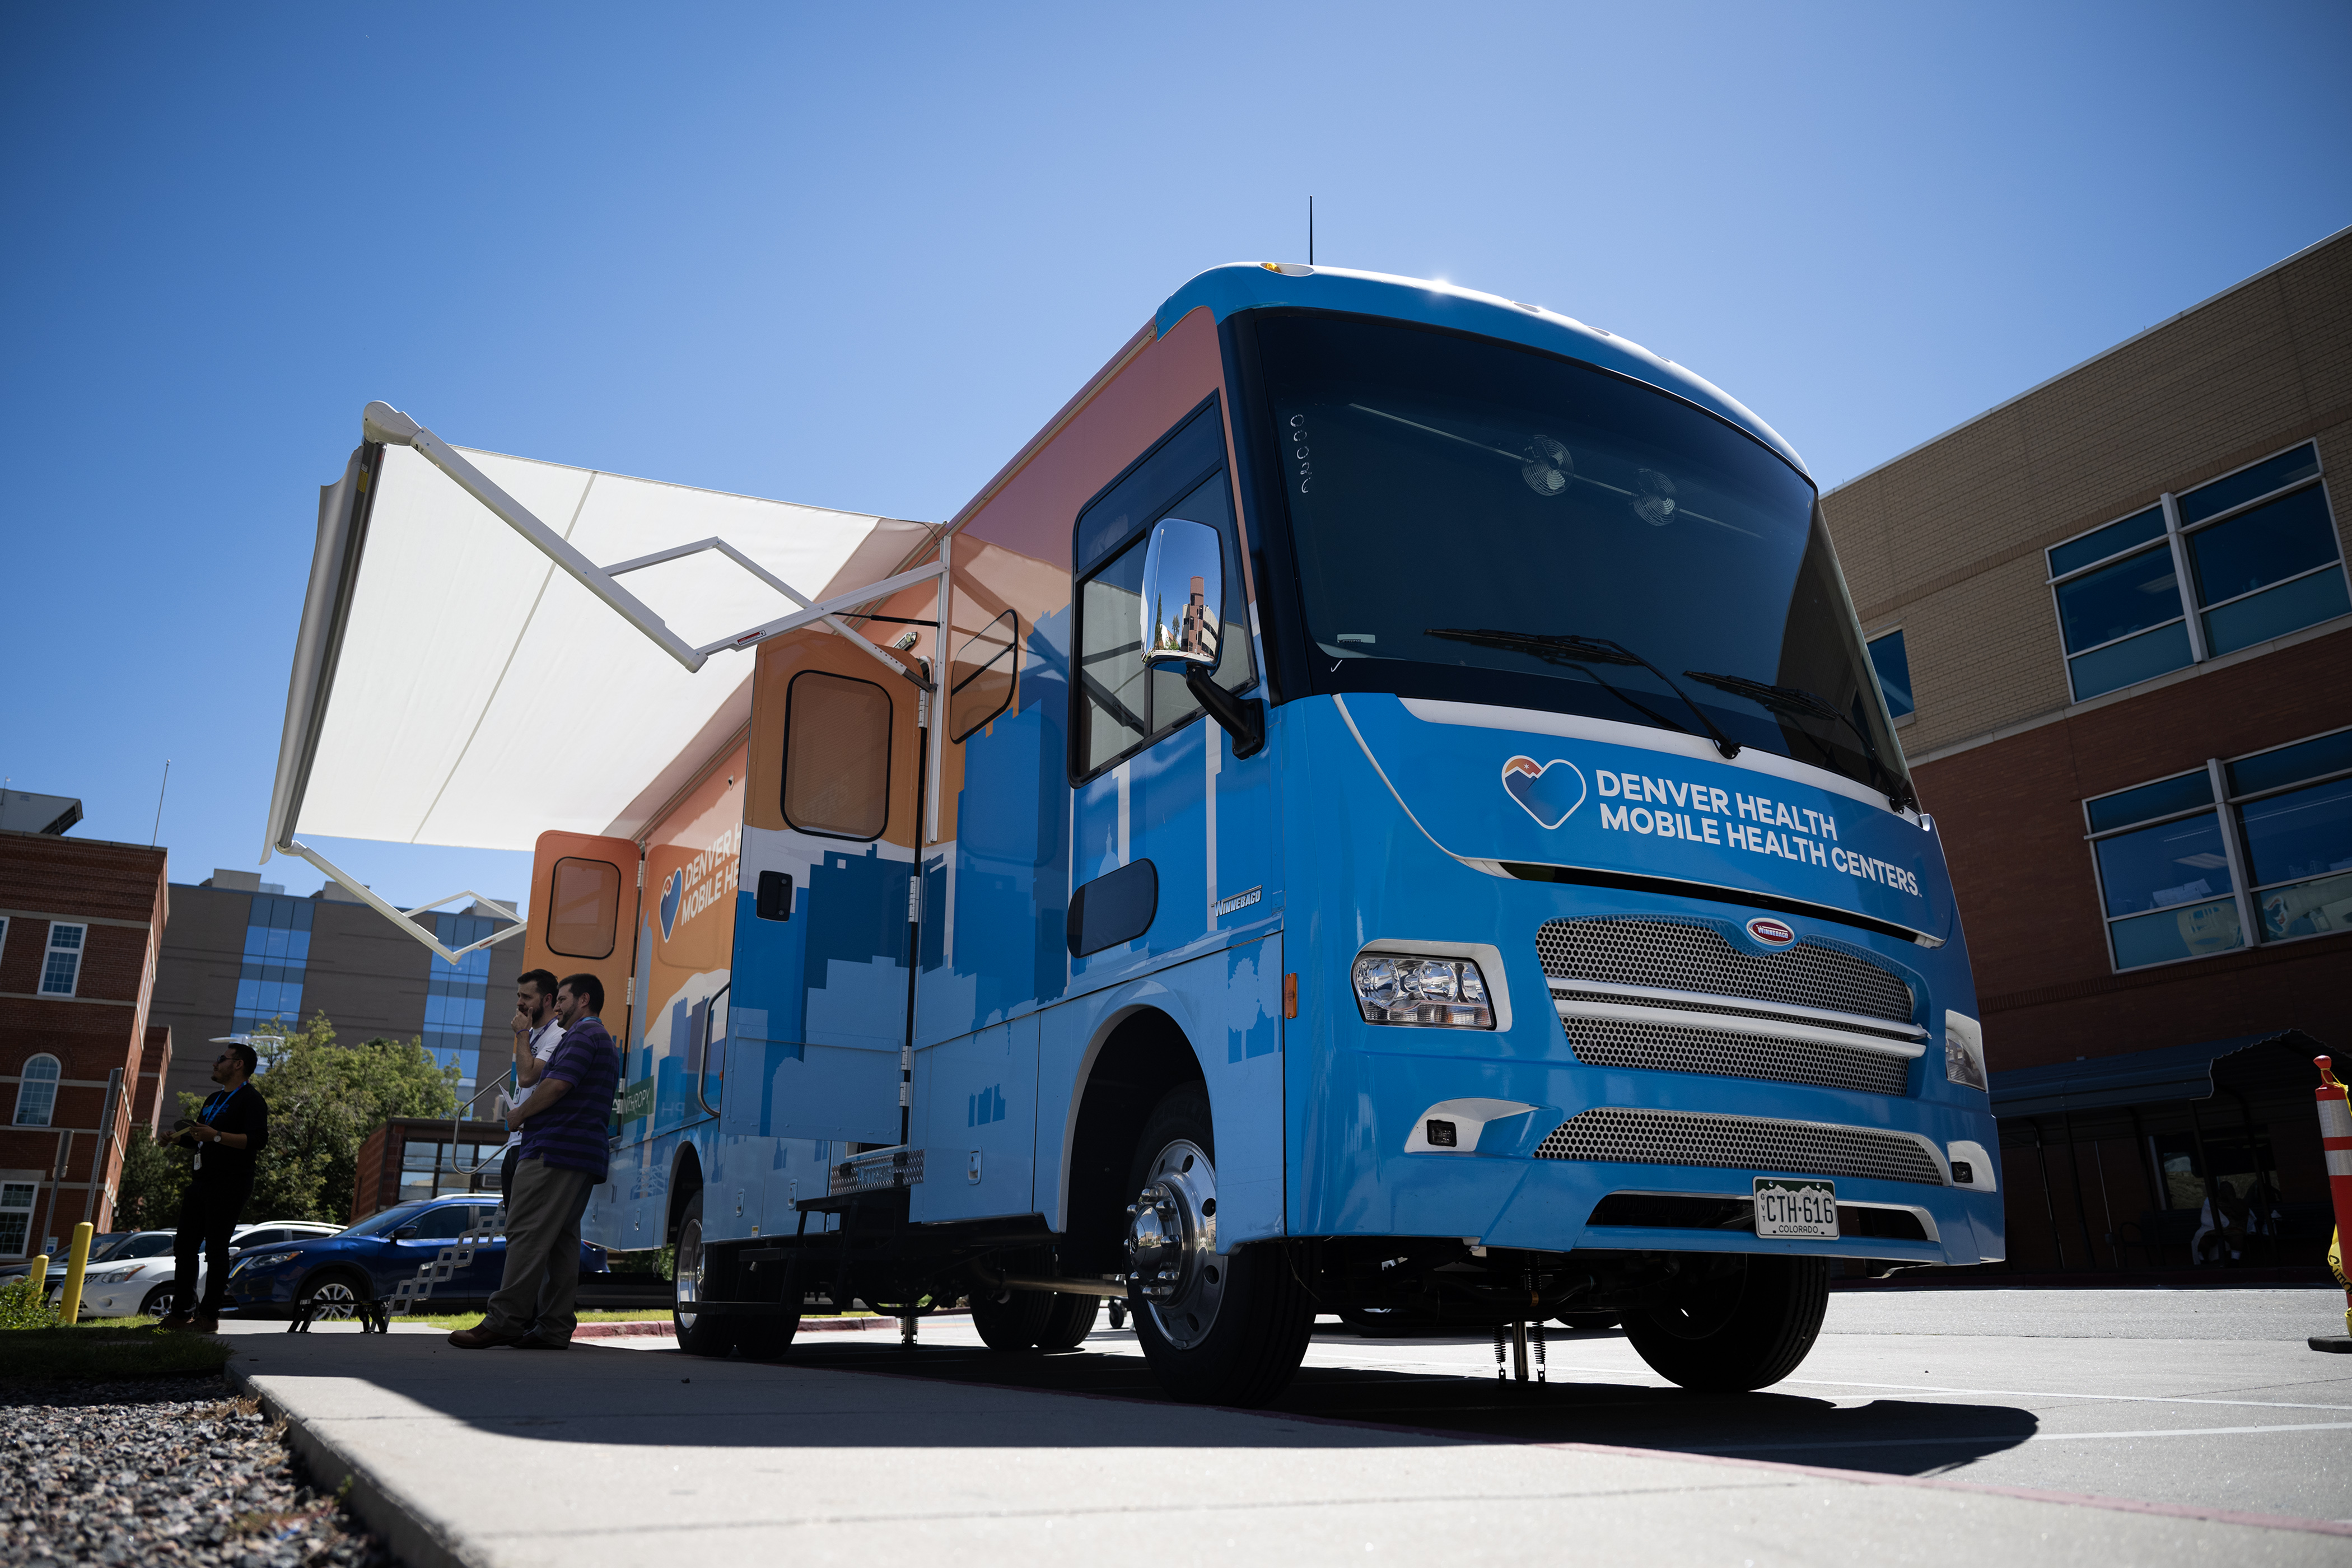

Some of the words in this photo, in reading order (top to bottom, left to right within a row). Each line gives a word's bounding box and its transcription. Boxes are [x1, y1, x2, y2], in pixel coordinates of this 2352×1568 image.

[1596, 769, 1732, 816] DENVER
[1735, 792, 1838, 841] HEALTH
[684, 829, 731, 892] DENVER
[1600, 803, 1721, 845] MOBILE
[1726, 822, 1827, 867] HEALTH
[1831, 847, 1919, 896] CENTERS
[681, 870, 723, 926] MOBILE
[1211, 886, 1262, 917] WINNEBAGO
[1756, 925, 1789, 939] WINNEBAGO
[1779, 1225, 1818, 1234] COLORADO
[2328, 1254, 2352, 1295] CUTIO
